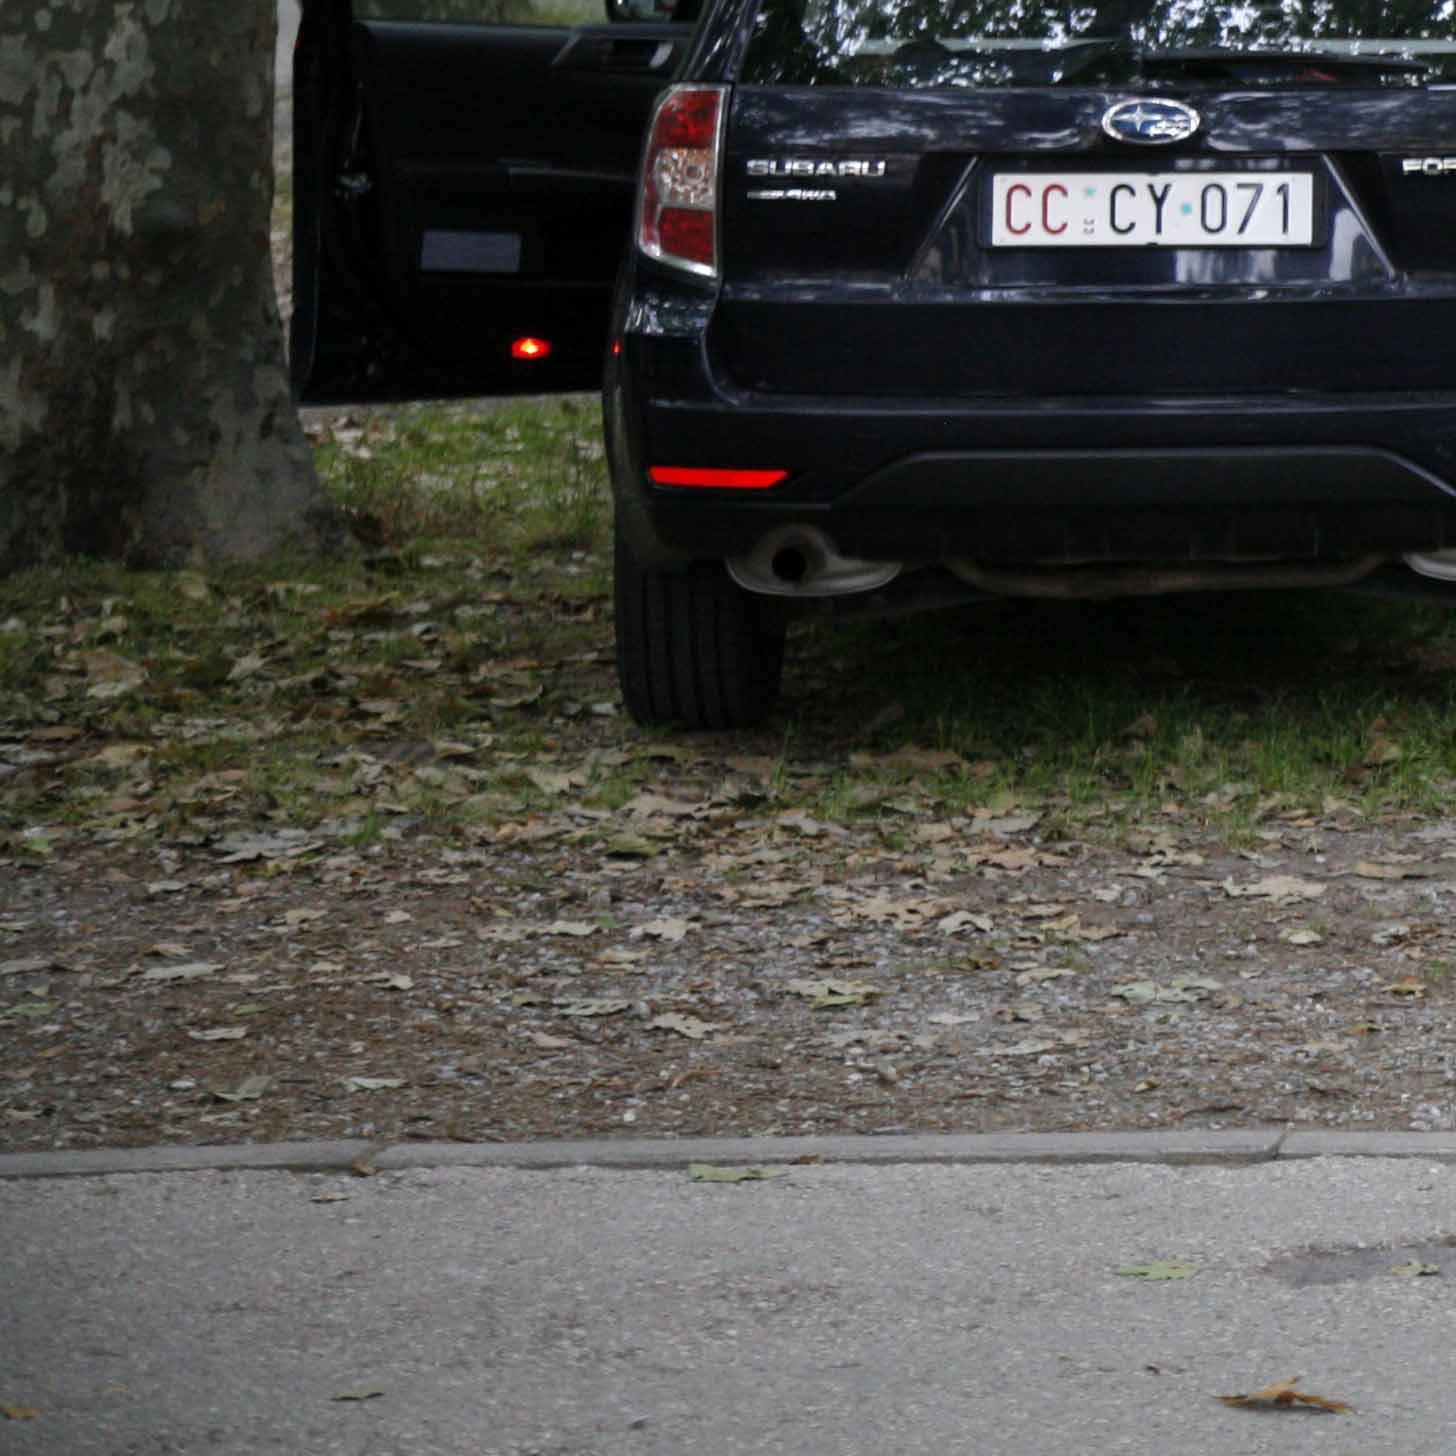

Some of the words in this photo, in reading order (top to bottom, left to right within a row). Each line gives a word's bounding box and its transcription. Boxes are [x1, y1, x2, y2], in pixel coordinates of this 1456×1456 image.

[746, 157, 886, 177] SUBARU
[1005, 183, 1069, 236] CC
[1109, 183, 1173, 236] CY
[1200, 183, 1291, 236] 071
